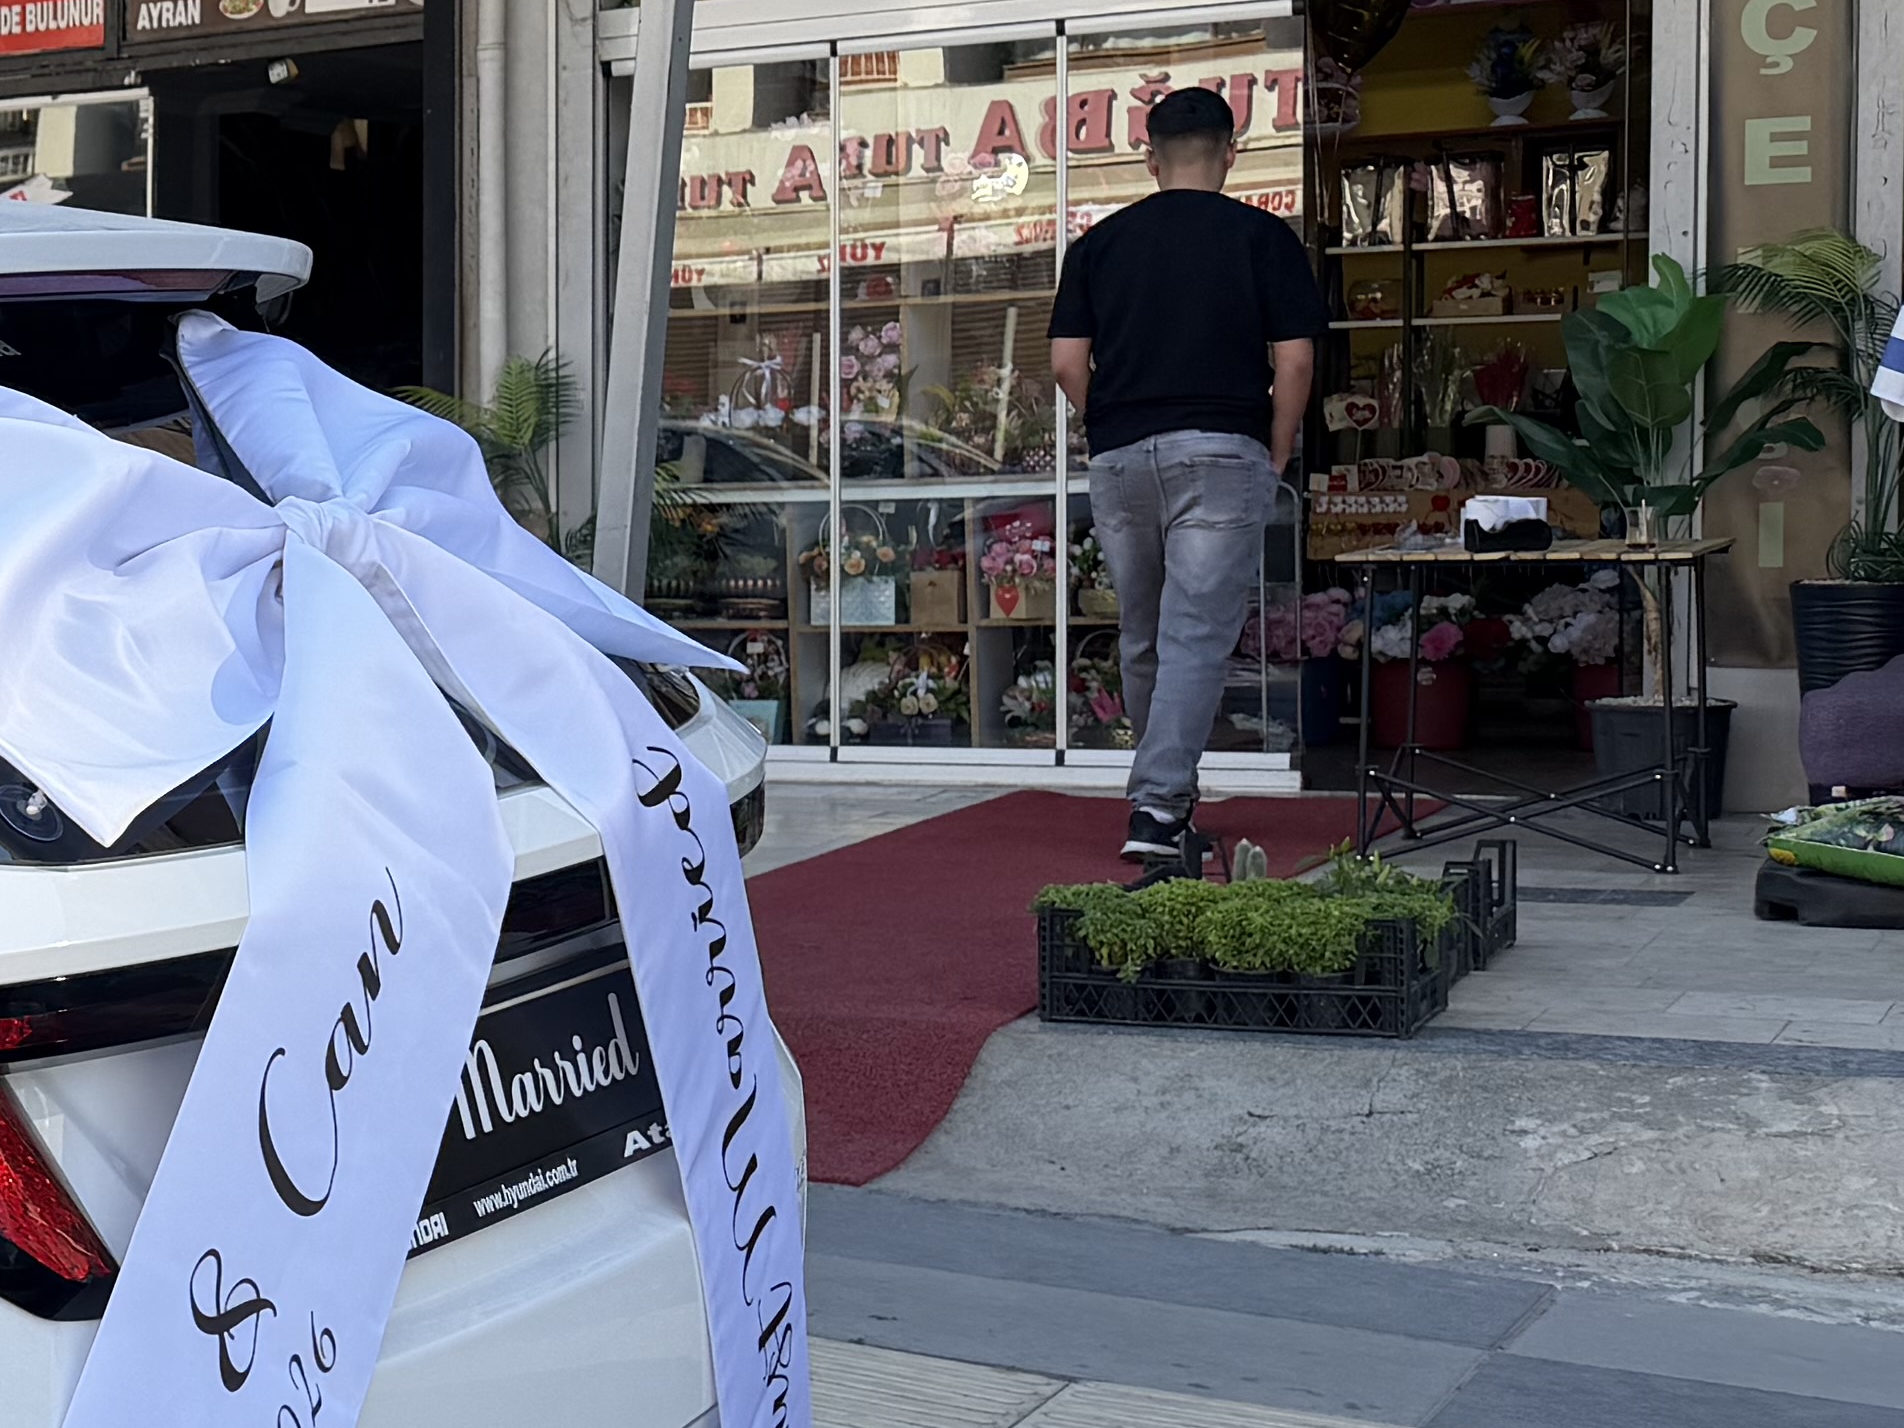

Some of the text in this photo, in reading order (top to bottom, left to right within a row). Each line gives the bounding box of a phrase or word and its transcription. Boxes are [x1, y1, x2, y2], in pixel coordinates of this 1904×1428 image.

[190, 1248, 278, 1393] &
[258, 867, 405, 1219] Can
[473, 1157, 579, 1217] www.hyundai.com.tr
[632, 744, 778, 1307] Married
